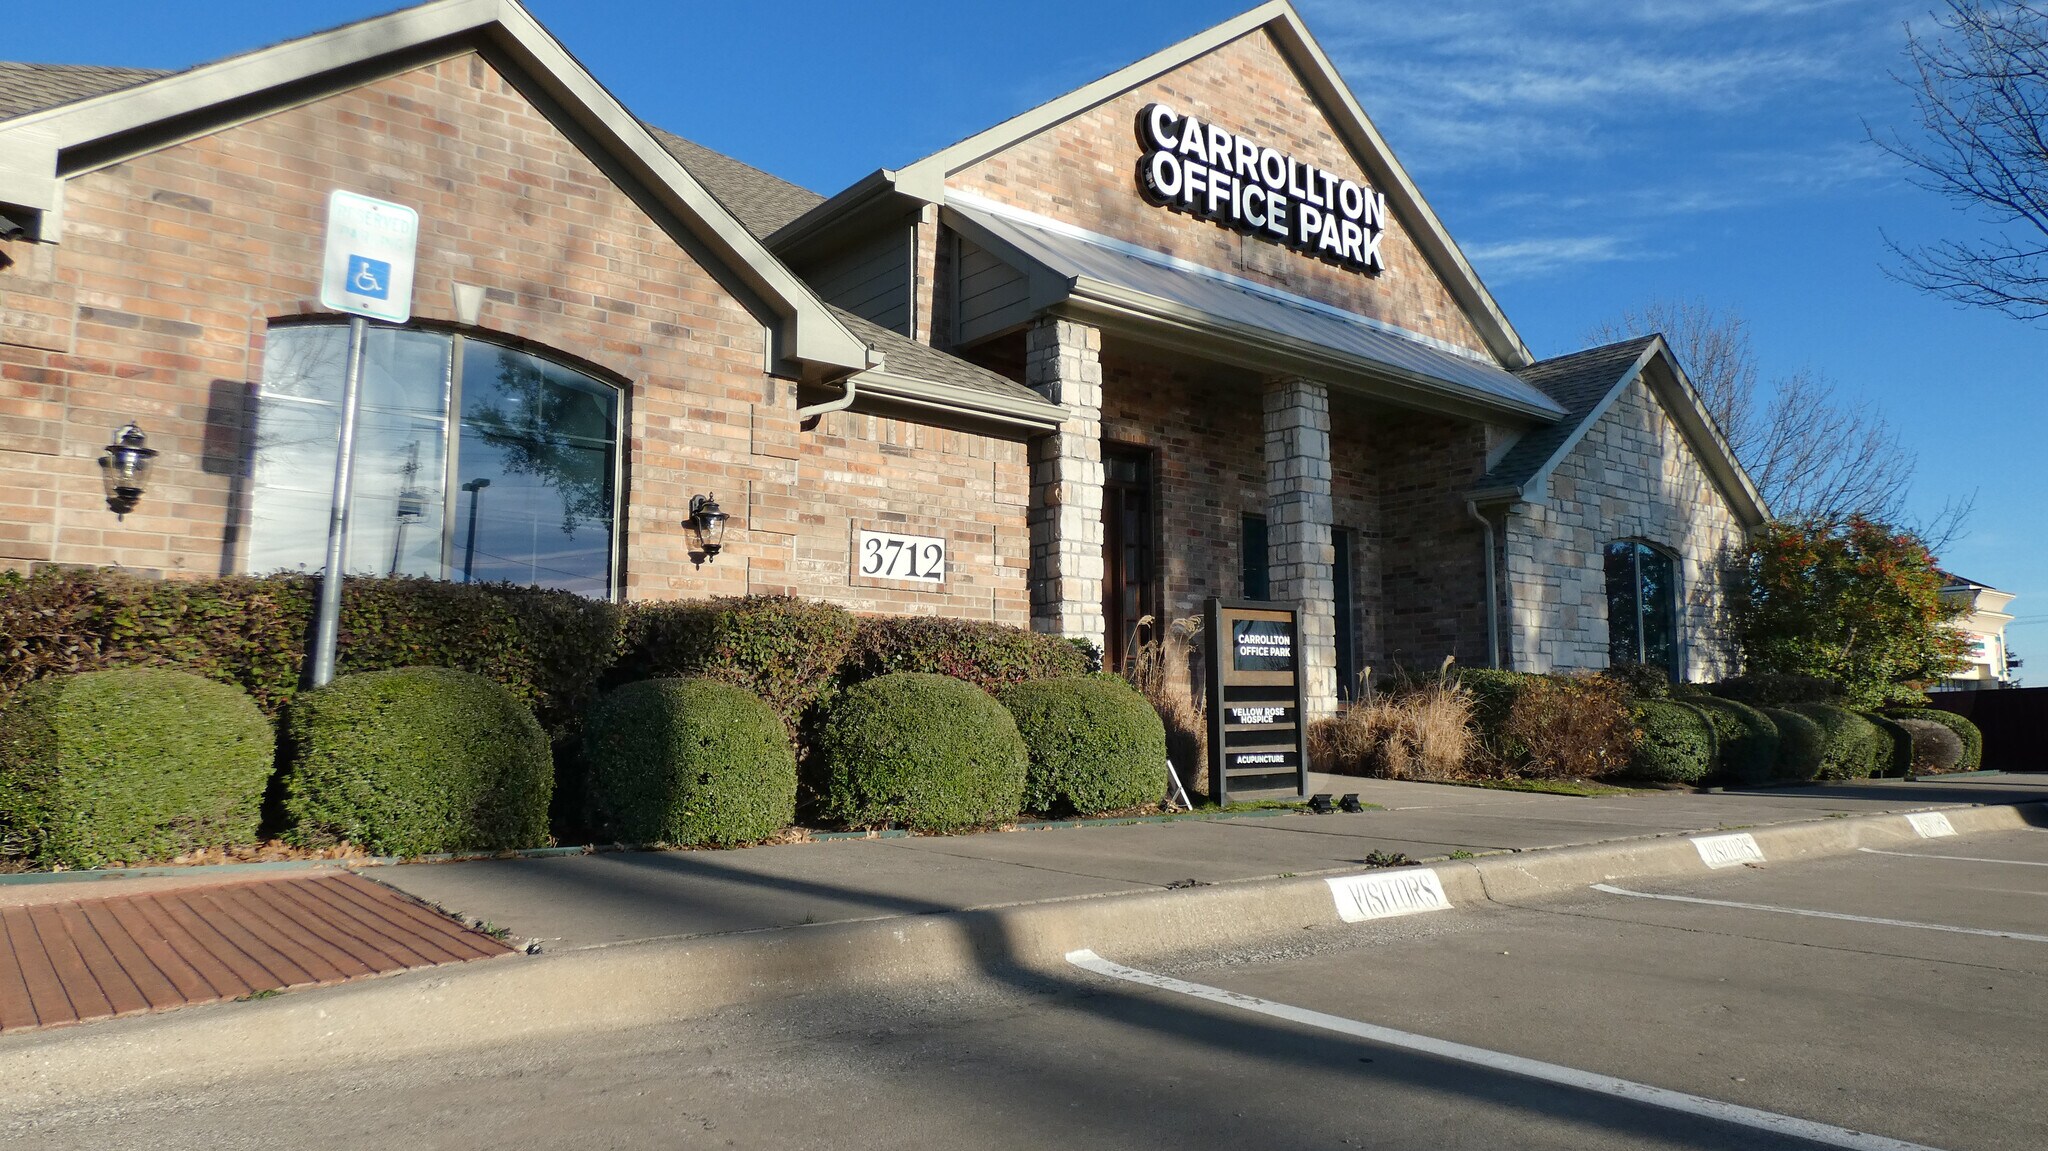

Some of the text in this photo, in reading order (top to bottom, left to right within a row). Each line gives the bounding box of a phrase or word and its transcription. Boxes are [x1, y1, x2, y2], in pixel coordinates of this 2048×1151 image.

[1150, 104, 1385, 229] CARROLLTON
[1152, 150, 1386, 271] OFFICE PARK
[862, 538, 943, 581] 3712
[1238, 634, 1290, 646] CARROLLTON
[1240, 646, 1291, 657] OFFICE PARK
[1232, 707, 1285, 717] YELLOW ROSE
[1240, 715, 1274, 724] HOSPICE
[1236, 754, 1285, 765] ACUPUNCTURE
[1347, 874, 1439, 917] VISITORS
